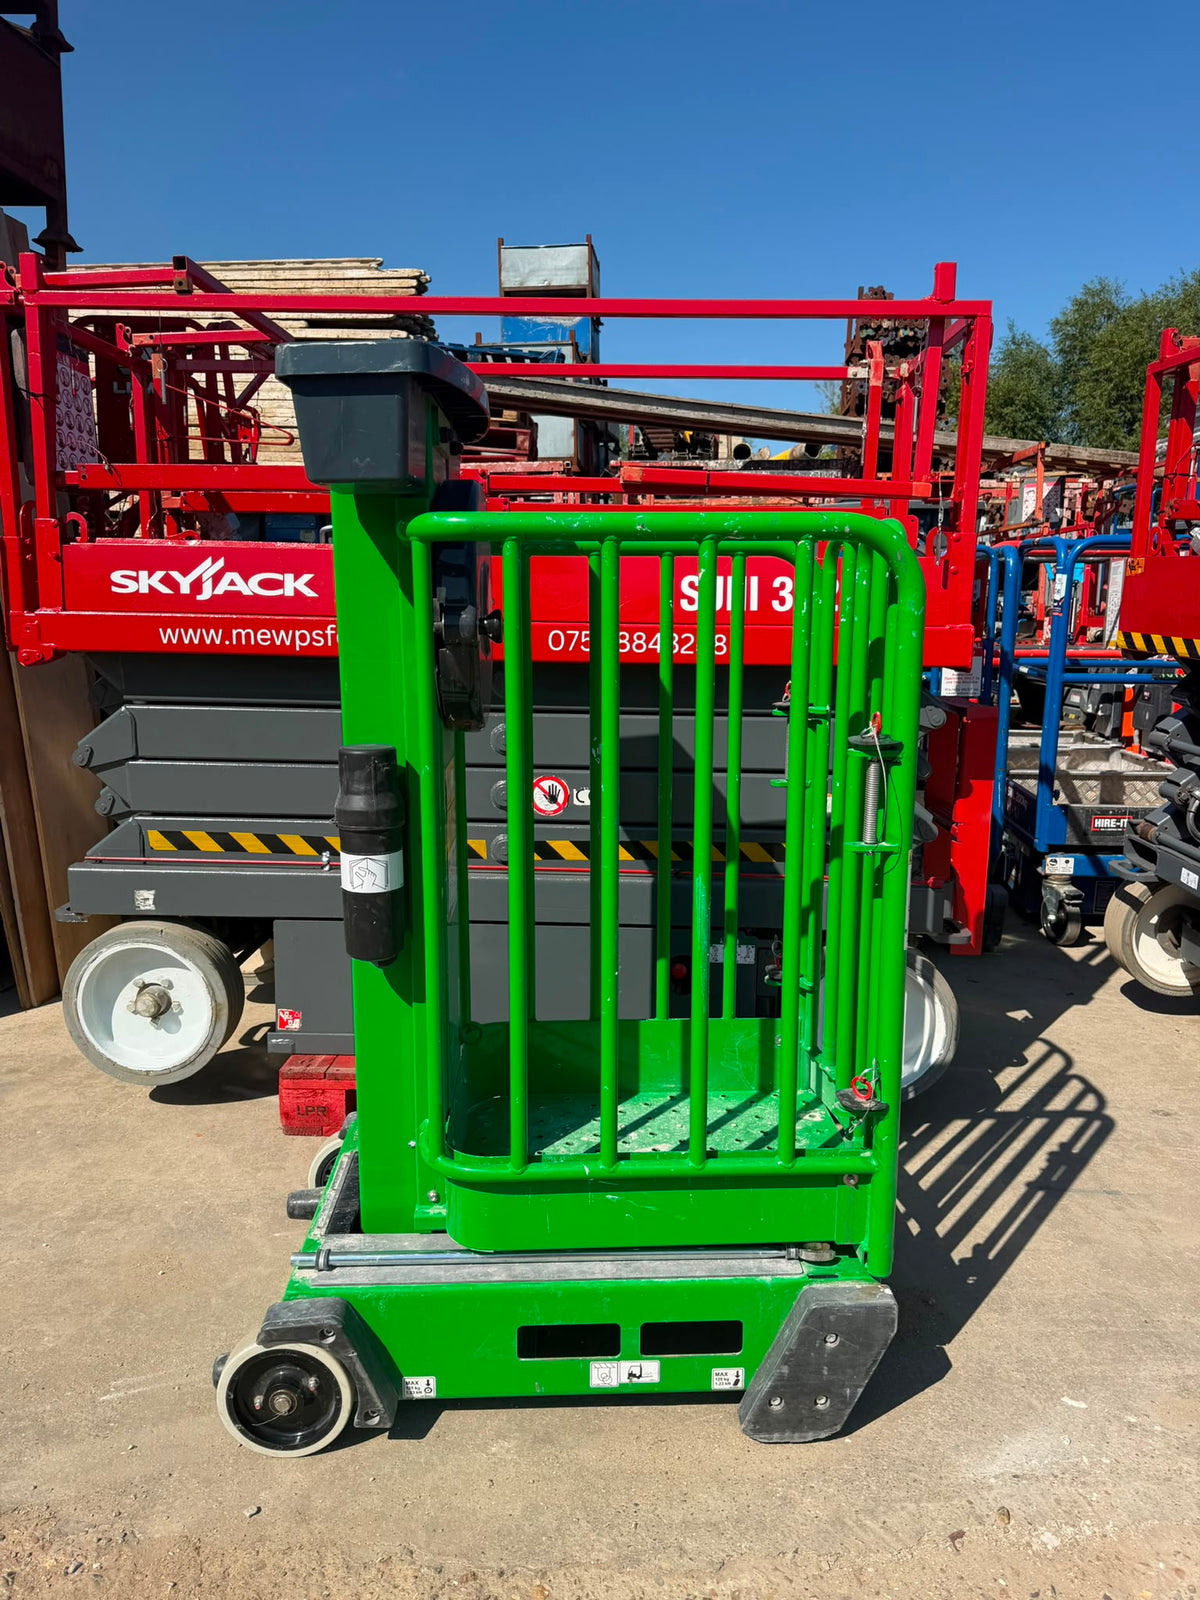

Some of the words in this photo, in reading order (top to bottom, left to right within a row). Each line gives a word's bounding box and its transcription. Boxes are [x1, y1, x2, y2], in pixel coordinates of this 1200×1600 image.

[110, 556, 319, 601] SKYJACK
[159, 624, 338, 651] www.mewpsf
[548, 629, 727, 655] 07588428
[296, 1105, 327, 1117] LPR
